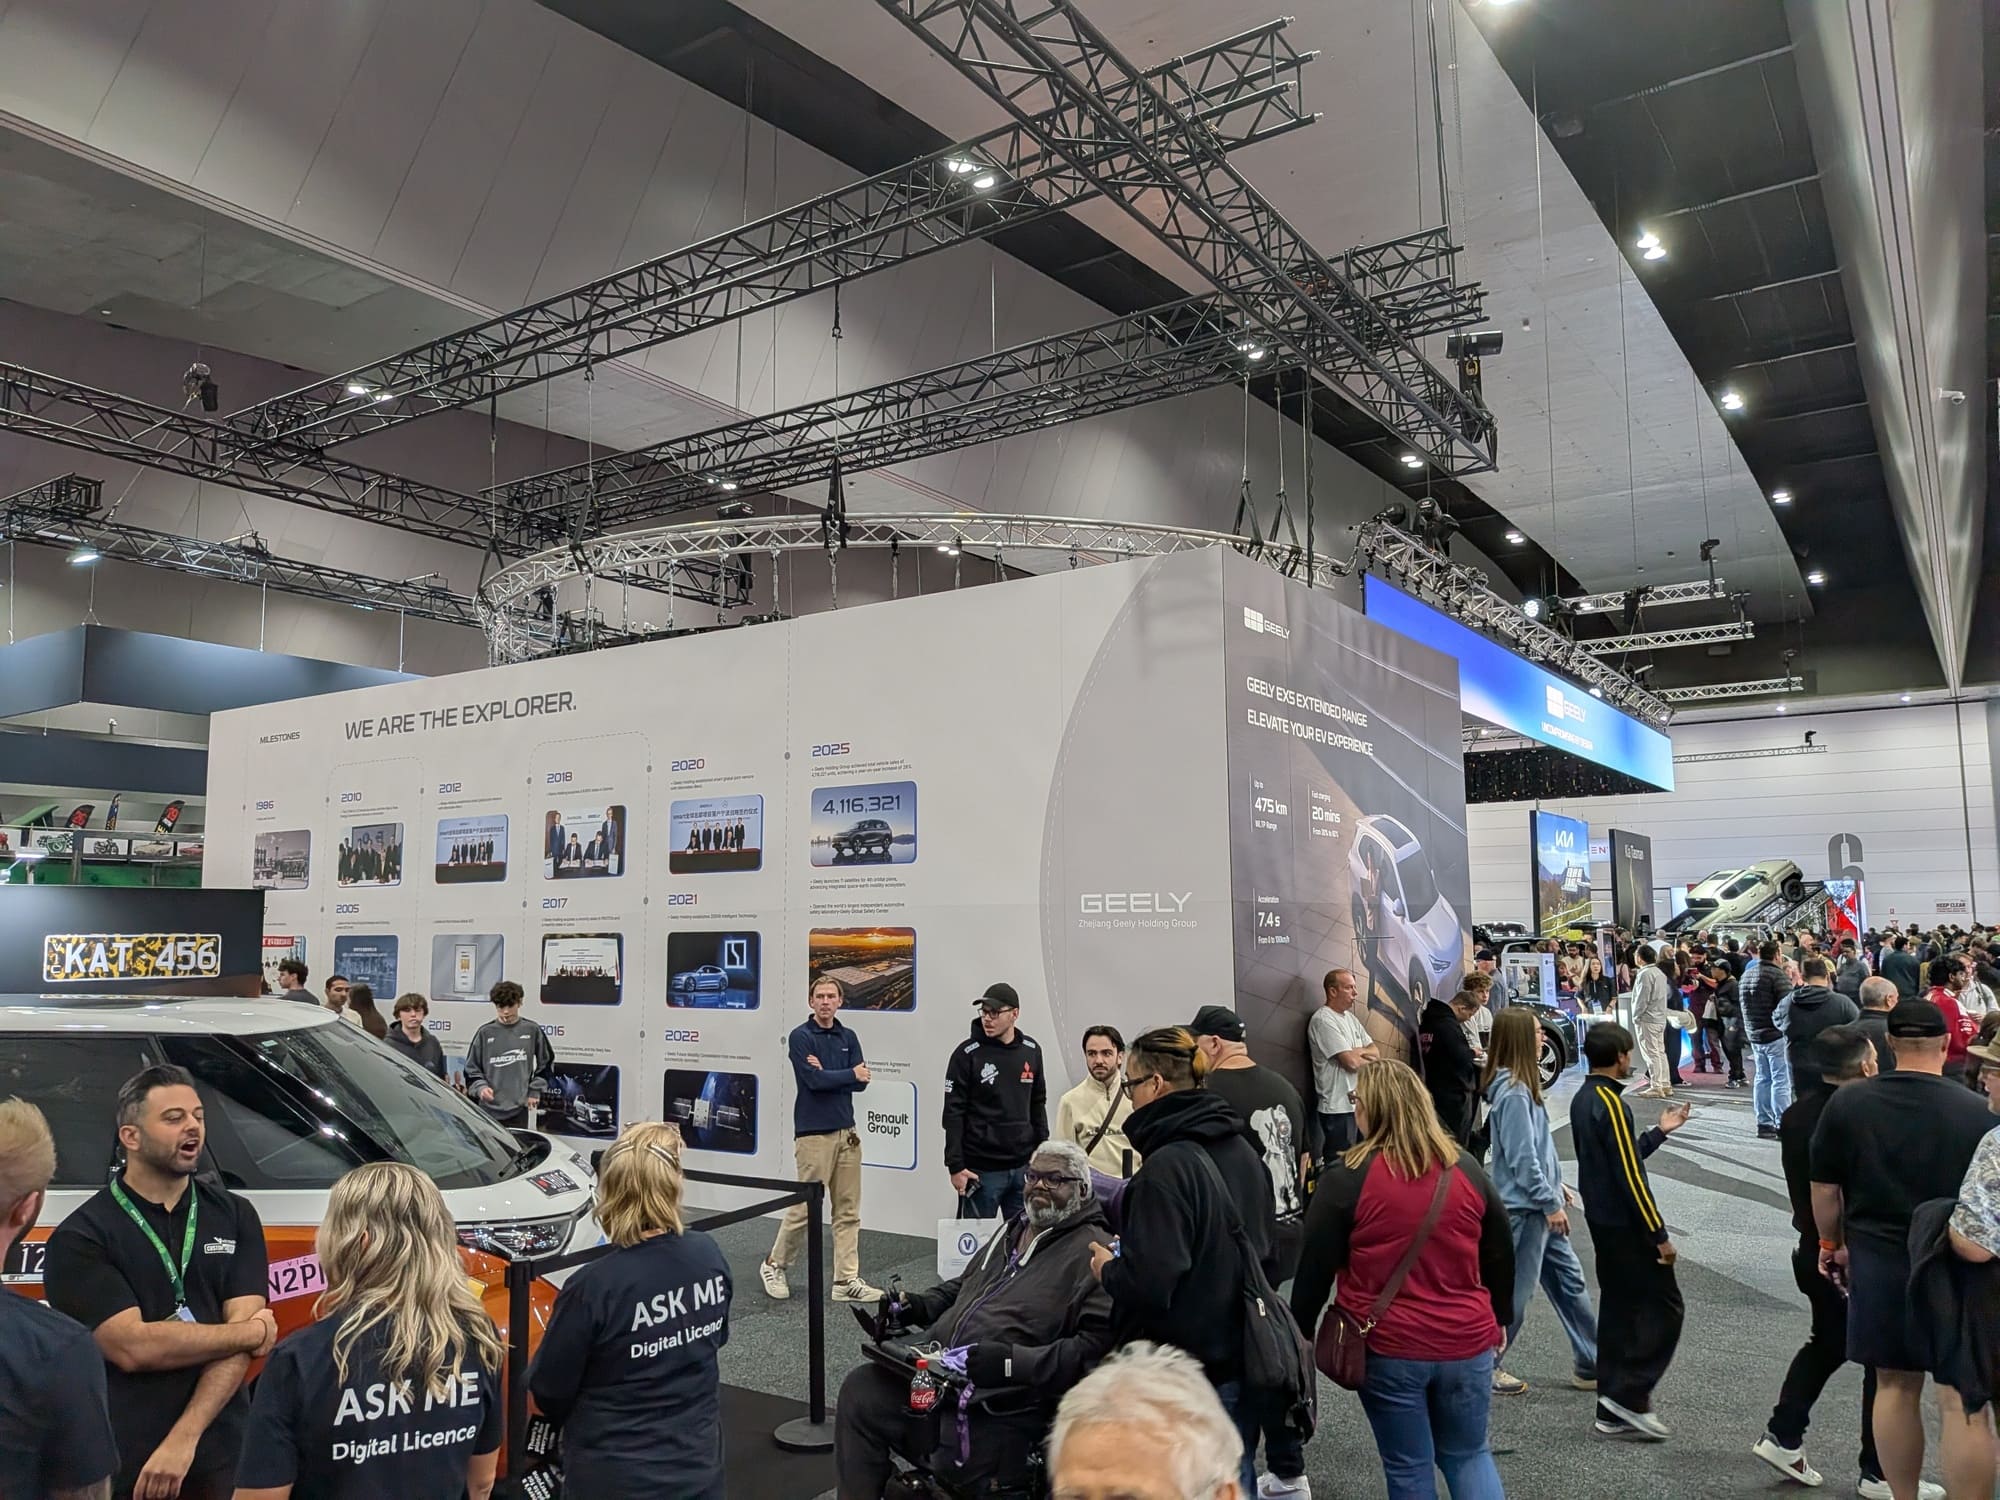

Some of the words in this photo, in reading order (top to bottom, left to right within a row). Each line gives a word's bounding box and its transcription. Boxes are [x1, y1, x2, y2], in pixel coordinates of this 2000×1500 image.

[1264, 620, 1290, 640] GEELY
[1246, 676, 1275, 699] GEELY
[1296, 693, 1342, 719] EXTENDED
[1342, 707, 1368, 728] RANGE
[345, 719, 374, 740] WE
[377, 713, 415, 737] ARE
[419, 707, 458, 731] THE
[462, 691, 577, 725] EXPLORER.
[260, 731, 300, 744] MILESTONES
[1247, 709, 1289, 733] ELEVATE
[1290, 720, 1315, 741] YOUR
[1315, 728, 1328, 744] EV
[1328, 731, 1374, 756] EXPERIENCE
[812, 742, 850, 757] 2025
[672, 759, 705, 771] 2020
[547, 771, 573, 783] 2018
[439, 782, 462, 793] 2012
[341, 792, 362, 803] 2010
[822, 794, 900, 815] 4,116,321
[1255, 797, 1274, 813] 475
[1275, 800, 1288, 816] km
[1312, 806, 1324, 820] 20
[1324, 808, 1341, 823] mins
[1828, 833, 1865, 881] 6
[542, 898, 568, 909] 2017
[668, 894, 698, 905] 2021
[1081, 891, 1193, 913] GEELY
[336, 904, 360, 914] 2005
[1078, 919, 1111, 929] Zhejiang
[1113, 919, 1136, 928] Geely
[1138, 919, 1170, 929] Holding
[1171, 918, 1198, 928] Group
[1258, 911, 1274, 927] 7.4
[1274, 915, 1280, 927] s
[51, 943, 62, 974] VIC
[65, 943, 133, 973] KAT
[155, 942, 217, 971] 456
[428, 1020, 452, 1031] 2013
[665, 1030, 699, 1042] 2022
[867, 1110, 909, 1125] Renault
[867, 1122, 901, 1138] Group
[287, 1257, 308, 1266] VIC
[631, 1287, 688, 1332] ASK
[693, 1275, 725, 1311] ME
[631, 1330, 683, 1358] Digital
[333, 1379, 412, 1426] ASK
[424, 1371, 480, 1412] ME
[332, 1434, 397, 1464] Digital
[403, 1425, 477, 1452] Licence
